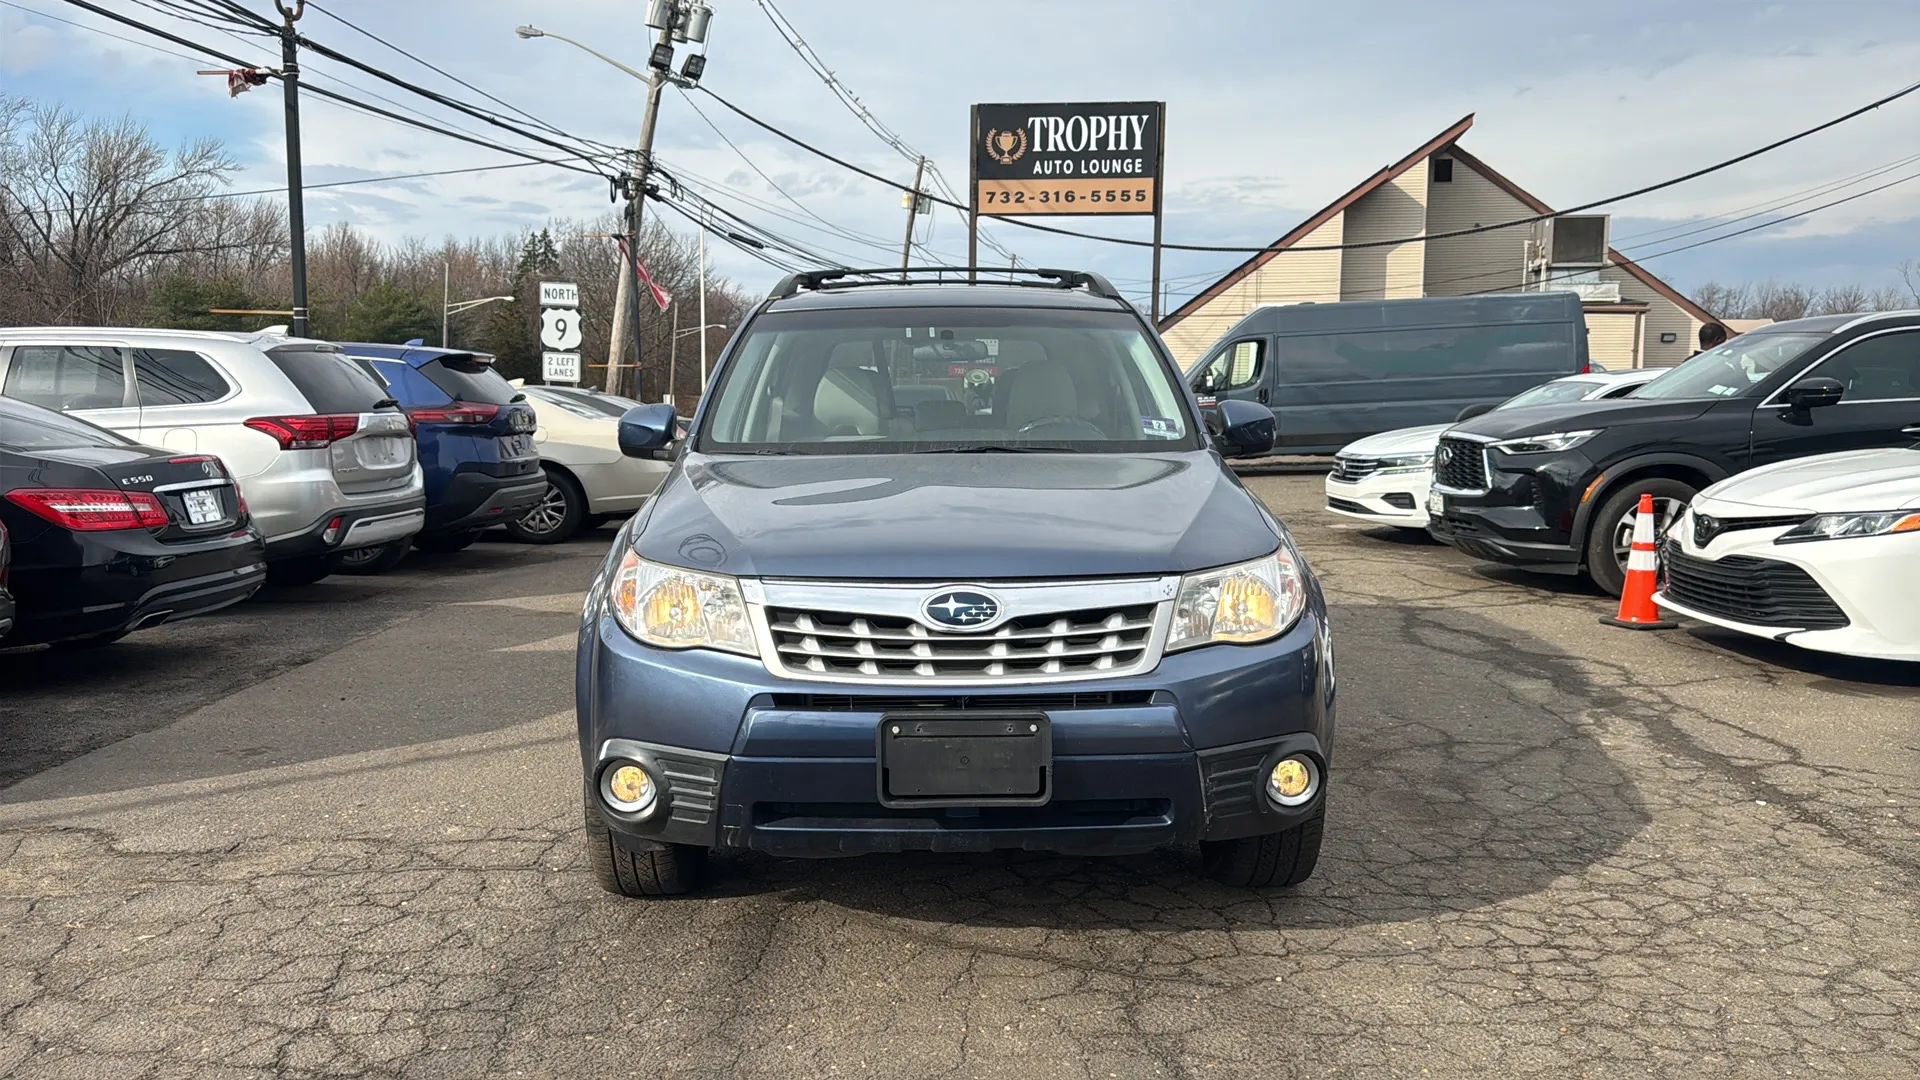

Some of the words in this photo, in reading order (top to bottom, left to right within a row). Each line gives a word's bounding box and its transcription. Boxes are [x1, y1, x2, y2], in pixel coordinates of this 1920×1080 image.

[1028, 115, 1149, 152] TROPHY
[1033, 159, 1073, 174] AUTO
[1081, 158, 1142, 173] LOUNGE
[986, 190, 1146, 203] 732-316-5555
[544, 288, 577, 300] NORTH
[555, 318, 567, 341] 9
[548, 356, 553, 366] 2
[556, 358, 575, 366] LEFT
[548, 367, 574, 377] LANES
